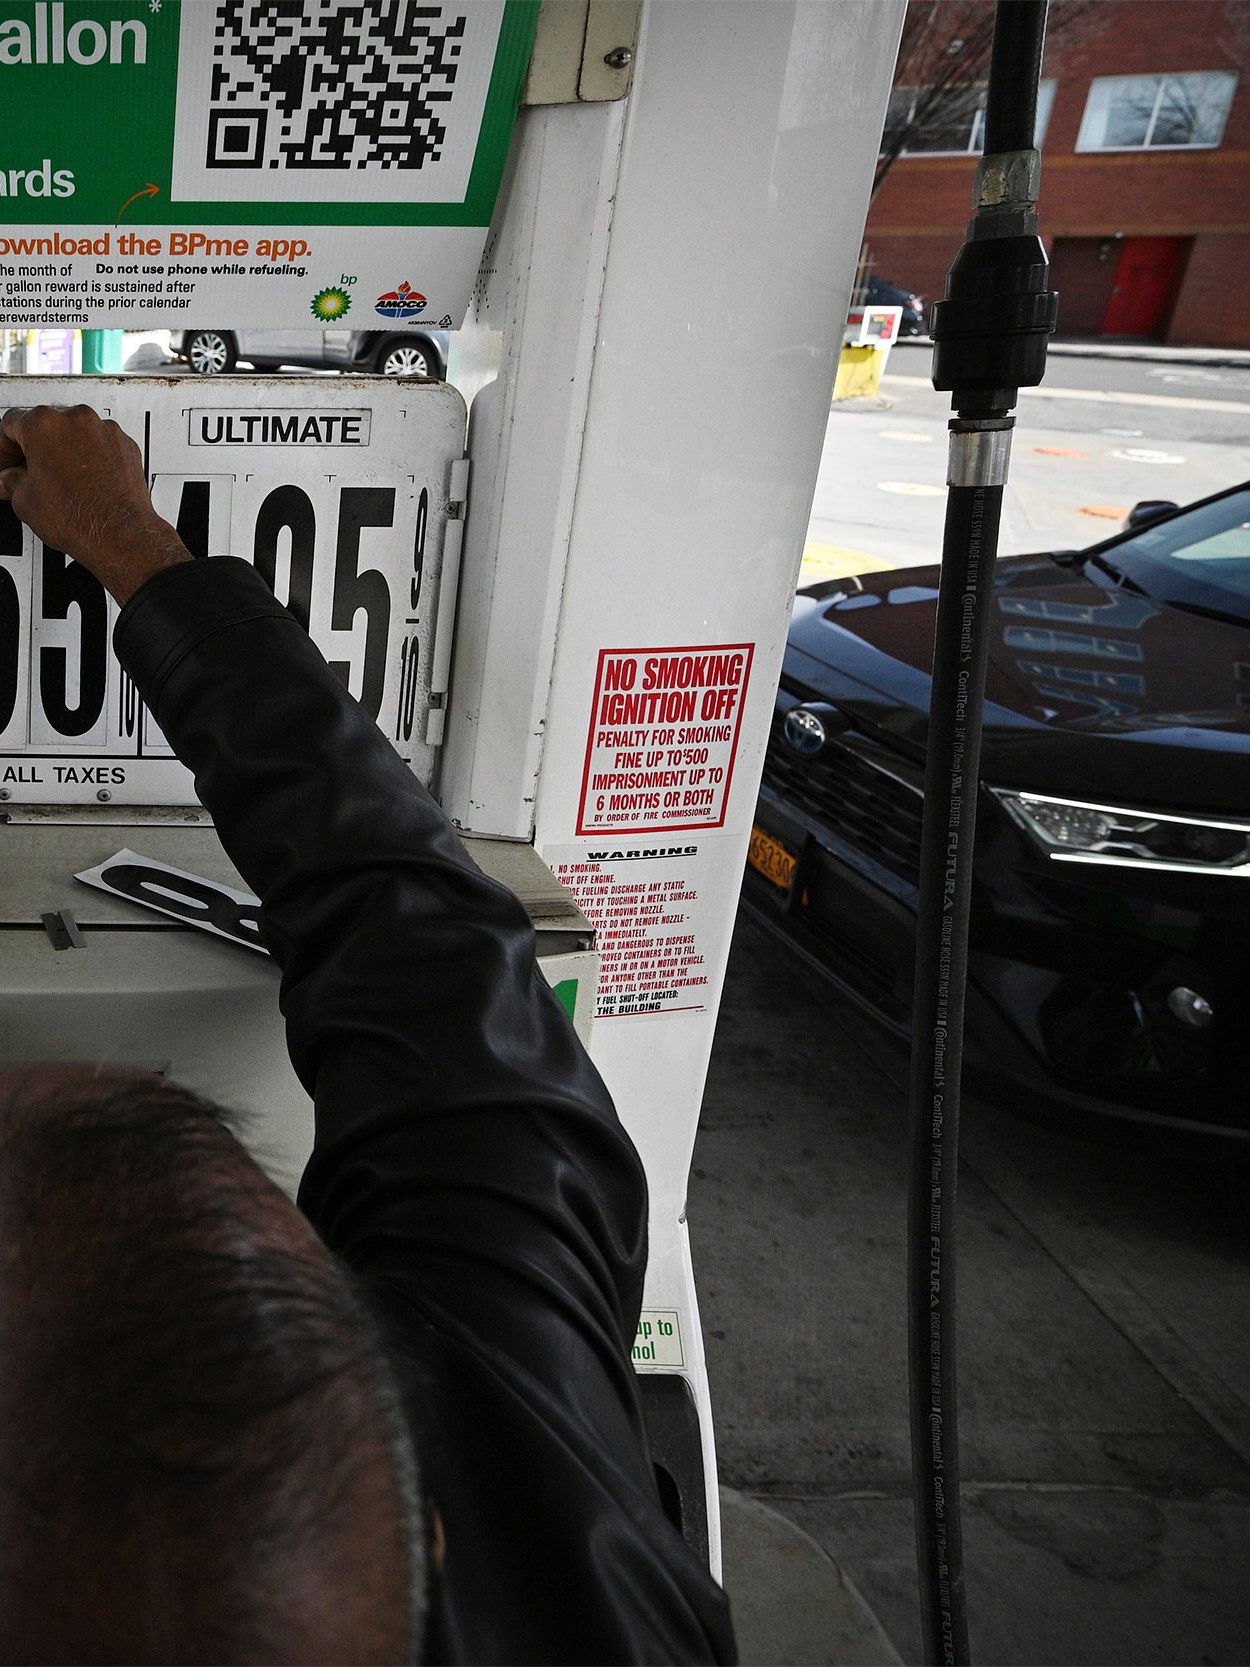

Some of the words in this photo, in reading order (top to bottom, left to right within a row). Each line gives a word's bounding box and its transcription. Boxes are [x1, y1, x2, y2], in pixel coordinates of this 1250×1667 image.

[116, 232, 162, 256] the
[169, 233, 249, 256] BPme
[256, 240, 312, 262] app.
[18, 264, 56, 276] month
[60, 263, 72, 276] of
[96, 263, 114, 274] Do
[117, 264, 139, 274] not
[142, 266, 164, 274] use
[168, 264, 208, 276] phone
[211, 264, 246, 275] while
[249, 264, 308, 278] refueling.
[6, 280, 42, 295] gallon
[45, 280, 88, 292] reward
[92, 280, 101, 292] is
[104, 280, 163, 293] sustained
[166, 280, 196, 293] after
[340, 274, 358, 286] bp
[45, 296, 82, 310] during
[85, 296, 105, 308] the
[108, 296, 136, 310] prior
[139, 296, 192, 308] calendar
[374, 300, 428, 308] AMOCO
[202, 416, 362, 444] ULTIMATE
[604, 658, 637, 691] NO
[642, 654, 744, 690] SMOKING
[956, 671, 969, 721] ContiTech
[600, 692, 698, 726] IGNITION
[700, 688, 738, 722] OFF
[596, 730, 650, 748] PENALTY
[651, 728, 675, 746] FOR
[677, 725, 732, 744] SMOKING
[614, 752, 644, 769] FINE
[646, 751, 664, 768] UP
[2, 766, 44, 783] ALL
[52, 767, 126, 784] TAXES
[592, 770, 687, 790] IMPRISONMENT
[688, 768, 706, 786] UP
[708, 767, 723, 784] TO
[596, 795, 605, 811] 6
[609, 792, 660, 811] MONTHS
[664, 791, 681, 808] OR
[683, 788, 714, 806] BOTH
[594, 814, 604, 822] BY
[606, 813, 630, 822] ORDER
[631, 812, 640, 820] OF
[643, 811, 659, 820] FIRE
[662, 808, 711, 818] COMMISSIONER
[588, 846, 698, 859] WARNING
[558, 864, 568, 874] NO
[570, 863, 602, 873] SMOKING.
[943, 831, 958, 912] FUTURA
[558, 876, 575, 885] SHUT
[576, 875, 588, 885] OFF
[590, 874, 616, 884] ENGINE.
[582, 886, 609, 896] FUELING
[610, 884, 646, 894] DISCHARGE
[648, 882, 662, 892] ANY
[663, 880, 685, 891] STATIC
[596, 898, 605, 906] BY
[607, 895, 638, 906] TOUCHING
[640, 895, 645, 904] A
[647, 893, 667, 903] METAL
[669, 890, 698, 901] SURFACE.
[605, 906, 638, 917] REMOVING
[640, 904, 664, 915] NOZZLE.
[602, 996, 617, 1005] FUEL
[619, 992, 650, 1004] SHUT-OFF
[650, 990, 679, 1000] LOCATED:
[598, 1006, 615, 1015] THE
[618, 1002, 661, 1014] BUILDING
[657, 1320, 672, 1336] to
